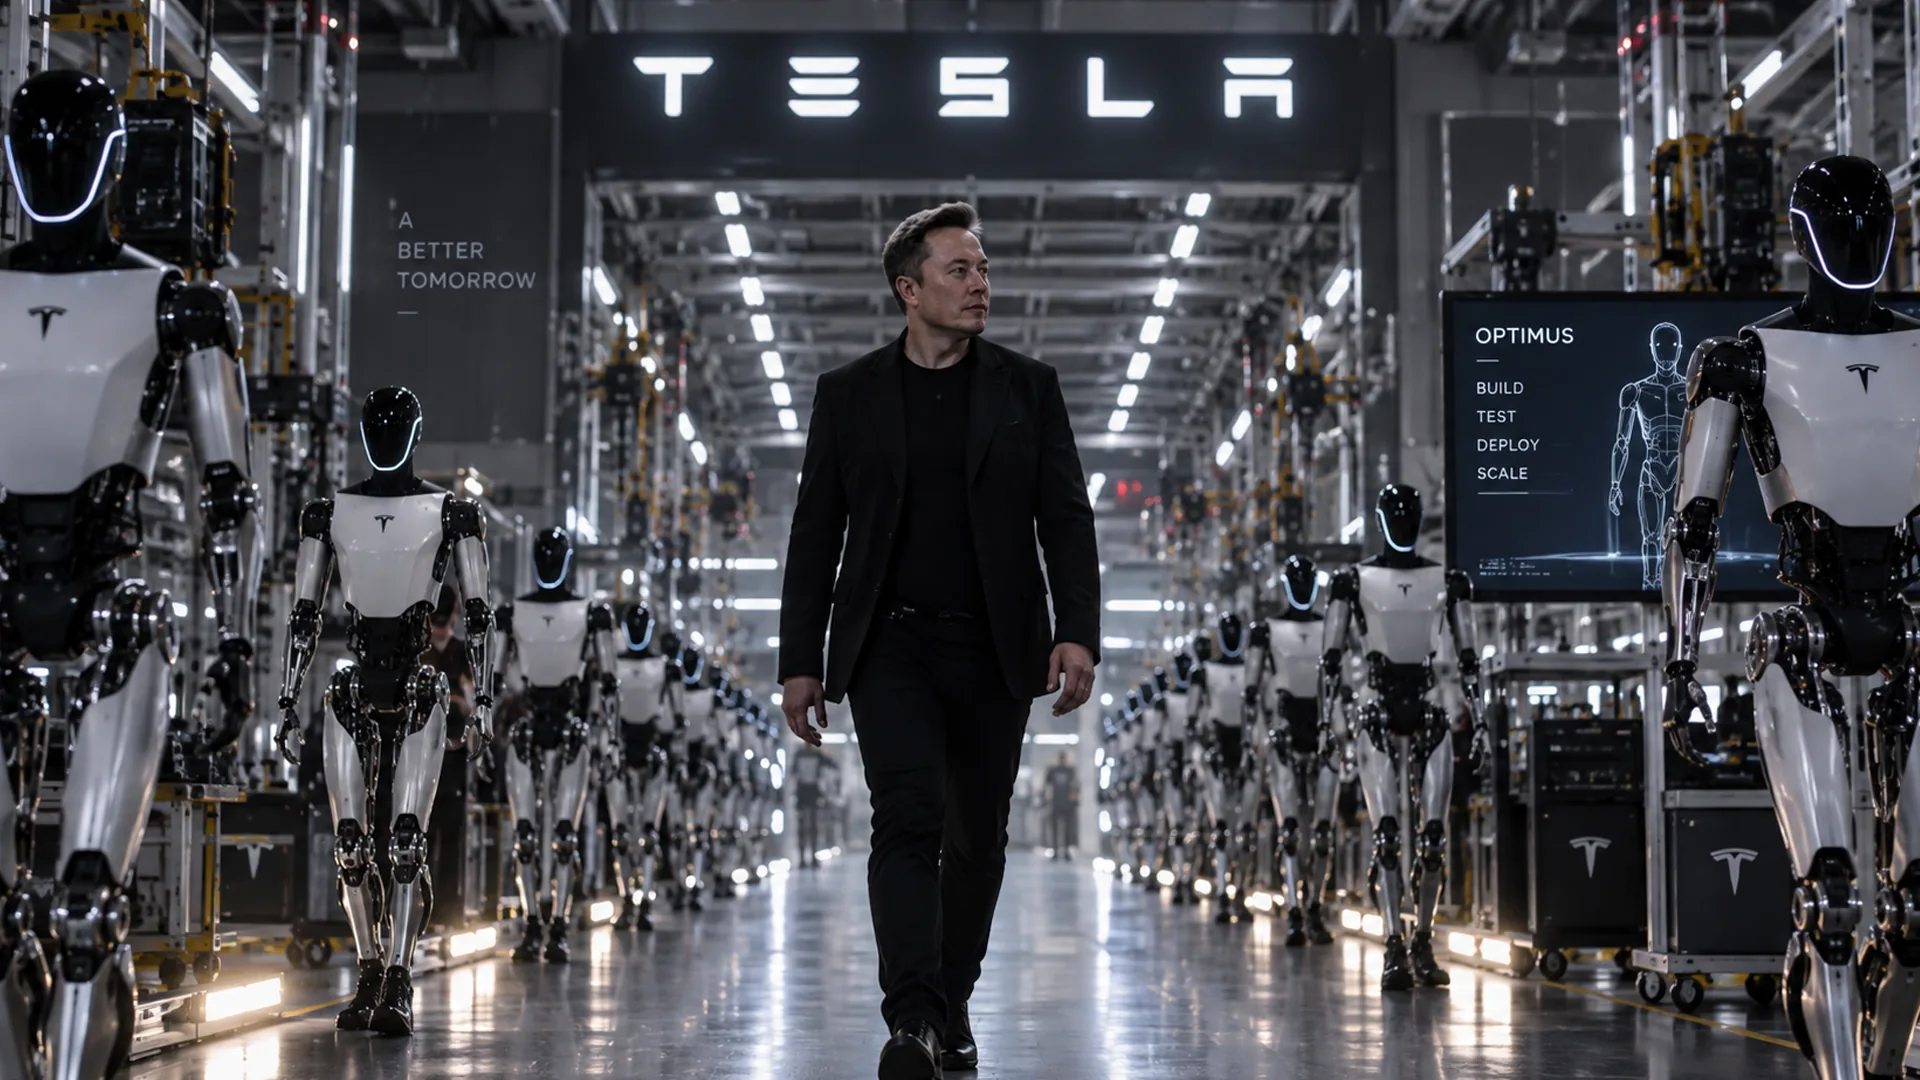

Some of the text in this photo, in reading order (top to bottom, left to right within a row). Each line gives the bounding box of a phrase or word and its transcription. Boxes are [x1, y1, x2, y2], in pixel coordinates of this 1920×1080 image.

[633, 56, 1294, 119] TESLA
[398, 211, 414, 229] A
[398, 241, 484, 260] BETTER
[397, 271, 536, 289] TOMORROW
[1475, 327, 1574, 345] OPTIMUS
[1476, 381, 1524, 395] BUILD
[1476, 410, 1517, 424] TEST
[1477, 438, 1540, 452] DEPLOY
[1477, 466, 1528, 480] SCALE
